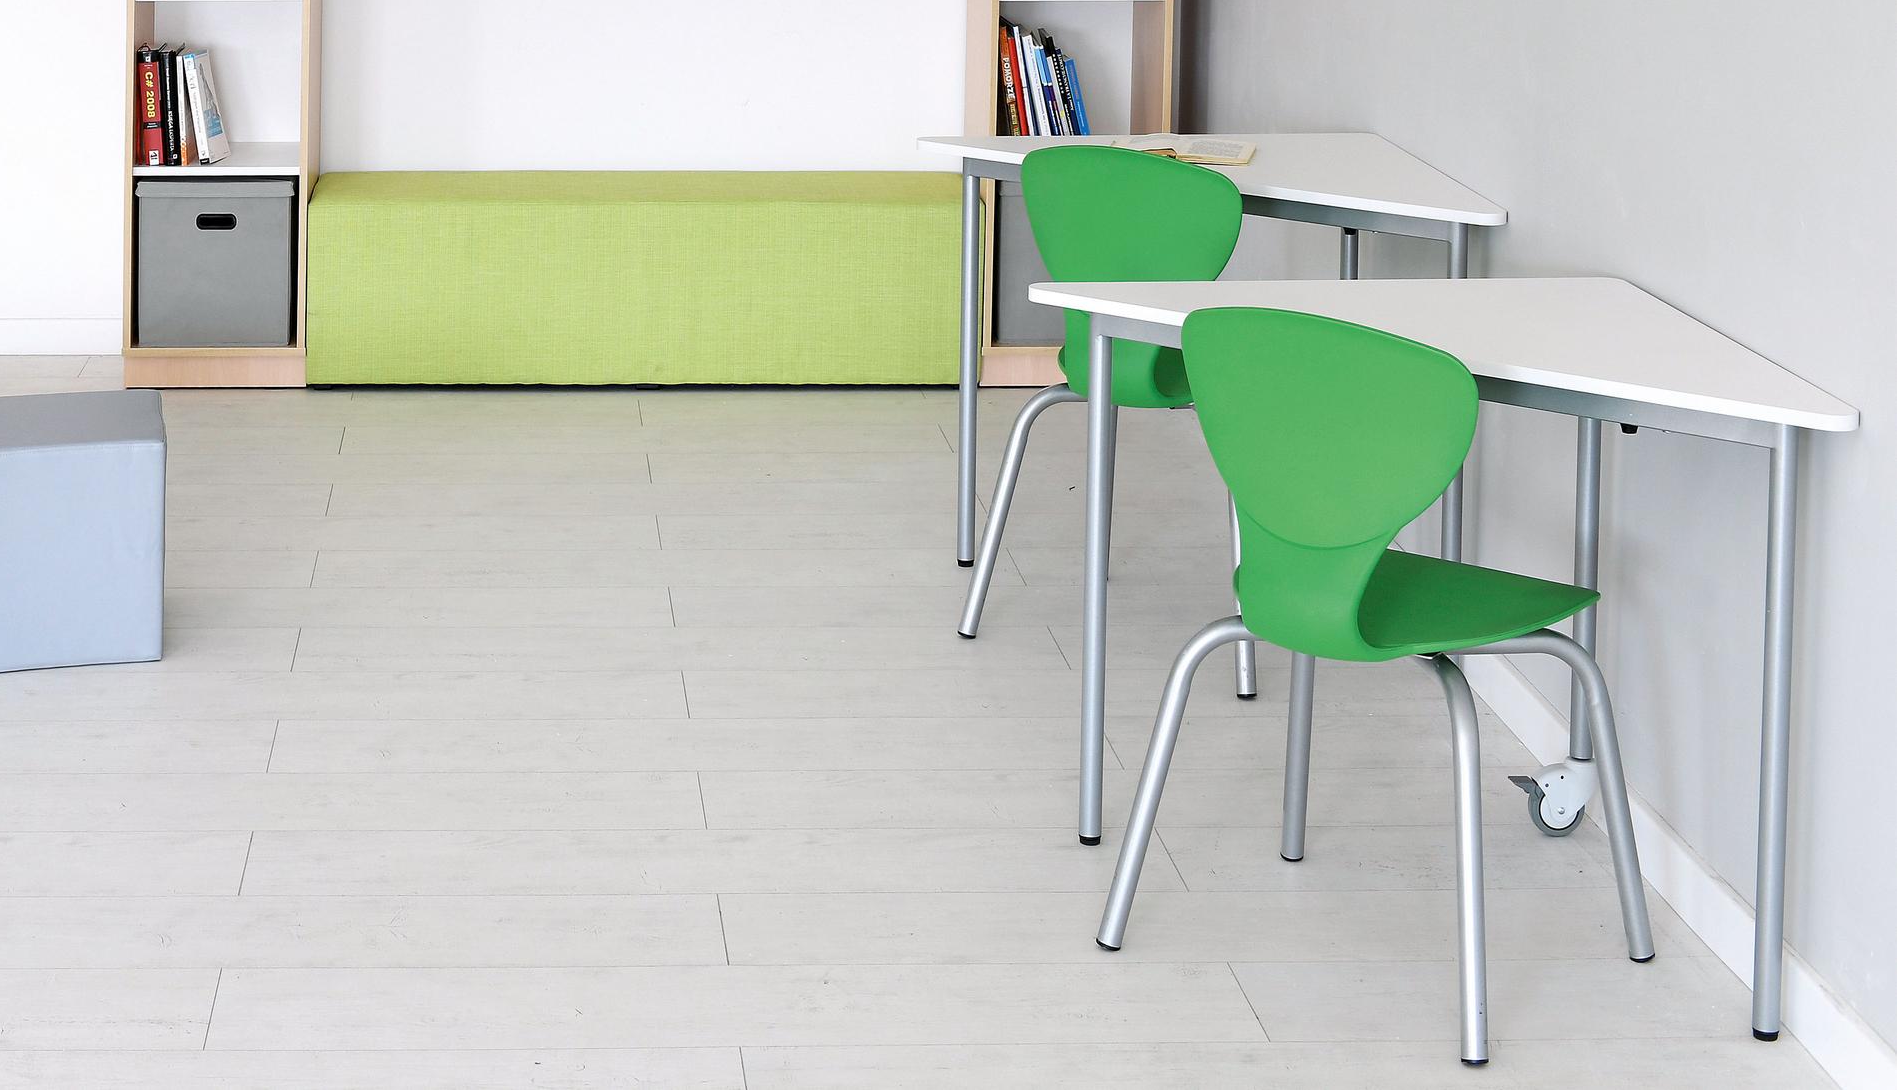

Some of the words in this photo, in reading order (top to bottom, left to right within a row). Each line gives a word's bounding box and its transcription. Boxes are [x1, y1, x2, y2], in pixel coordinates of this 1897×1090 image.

[145, 72, 153, 87] C#
[1003, 58, 1015, 99] POMORZE
[146, 90, 155, 118] 2008
